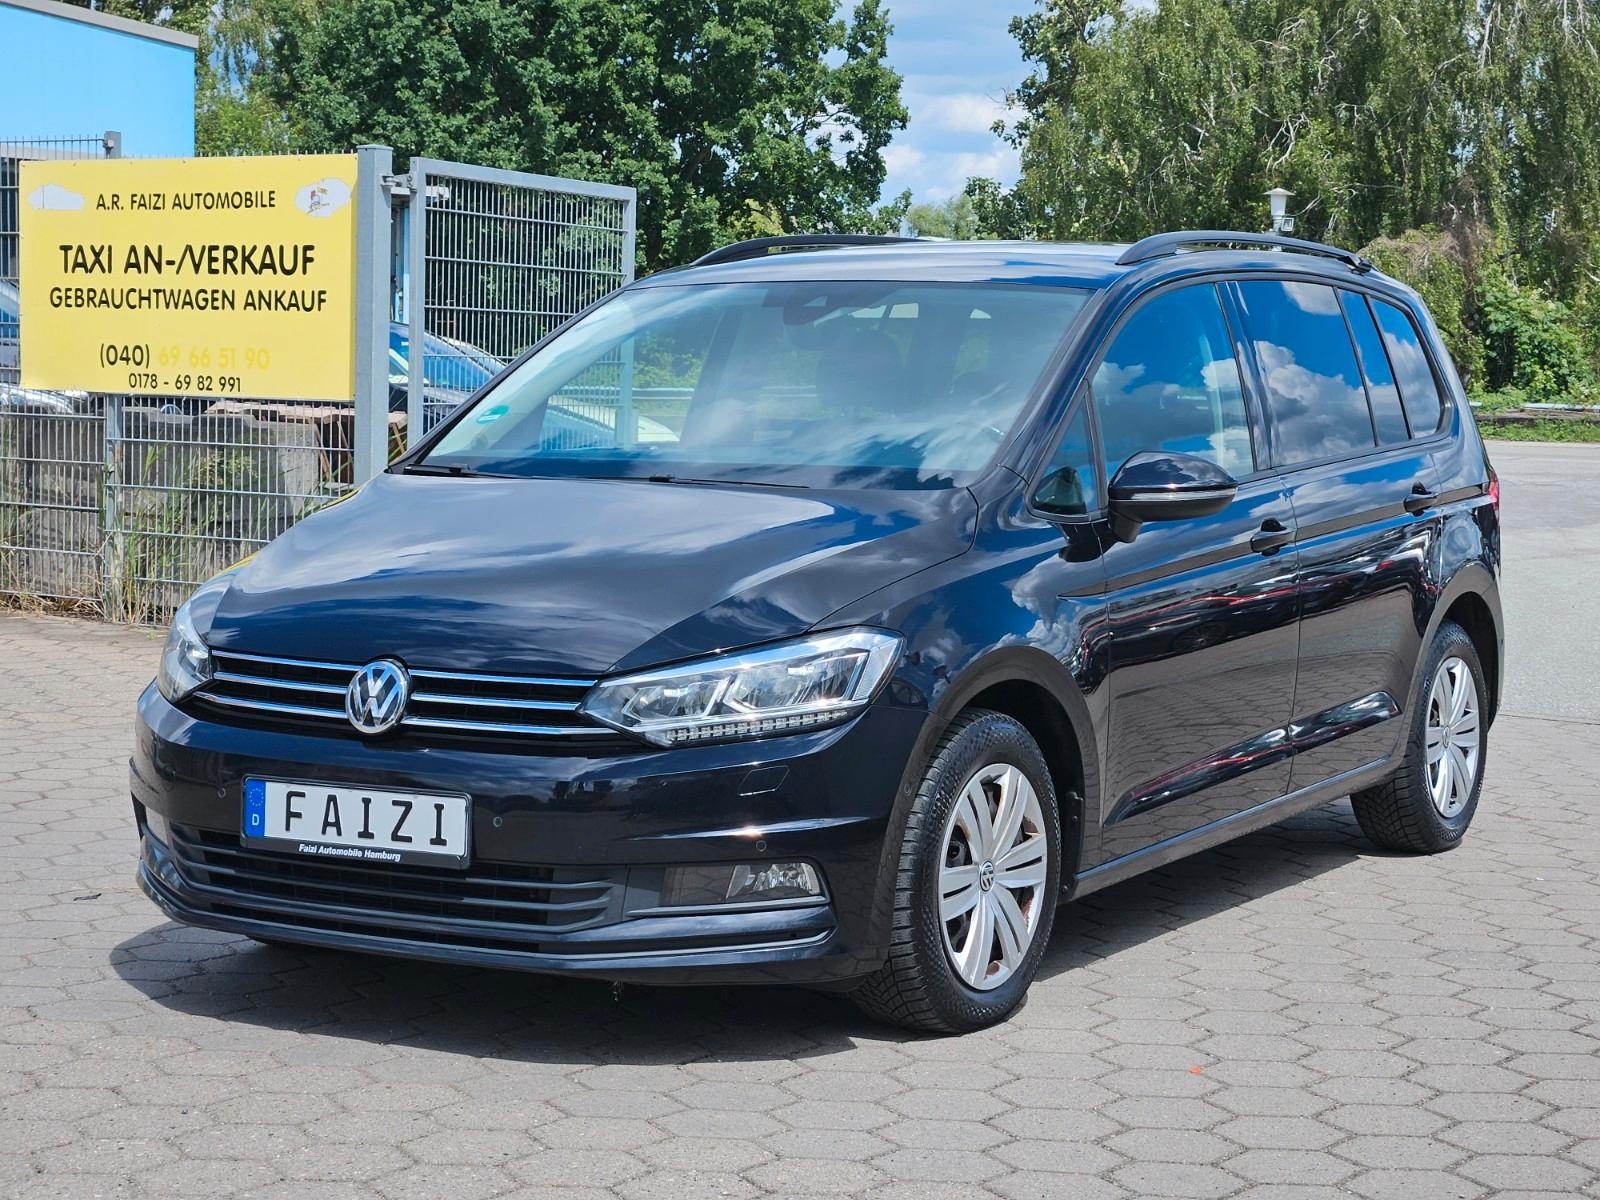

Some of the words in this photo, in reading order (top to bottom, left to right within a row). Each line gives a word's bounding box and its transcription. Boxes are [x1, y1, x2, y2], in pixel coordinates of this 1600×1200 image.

[96, 193, 125, 211] A.R.
[130, 192, 166, 211] FAIZI
[171, 190, 277, 211] AUTOMOBILE
[59, 244, 113, 275] TAXI
[124, 243, 316, 276] AN-/VERKAUF
[49, 286, 236, 312] GEBRAUCHTWAGEN
[243, 289, 328, 313] ANKAUF
[99, 343, 150, 369] (040)
[158, 345, 181, 368] 69
[188, 345, 212, 368] 66
[217, 346, 237, 369] 51
[243, 347, 271, 370] 90
[128, 373, 158, 389] 0178
[175, 374, 192, 391] 69
[197, 375, 213, 391] 82
[218, 376, 241, 393] 991
[251, 813, 260, 826] D
[284, 790, 448, 847] FAIZI
[298, 843, 318, 853] Faizi
[318, 845, 362, 858] Automobile
[363, 849, 401, 863] Hamburg
